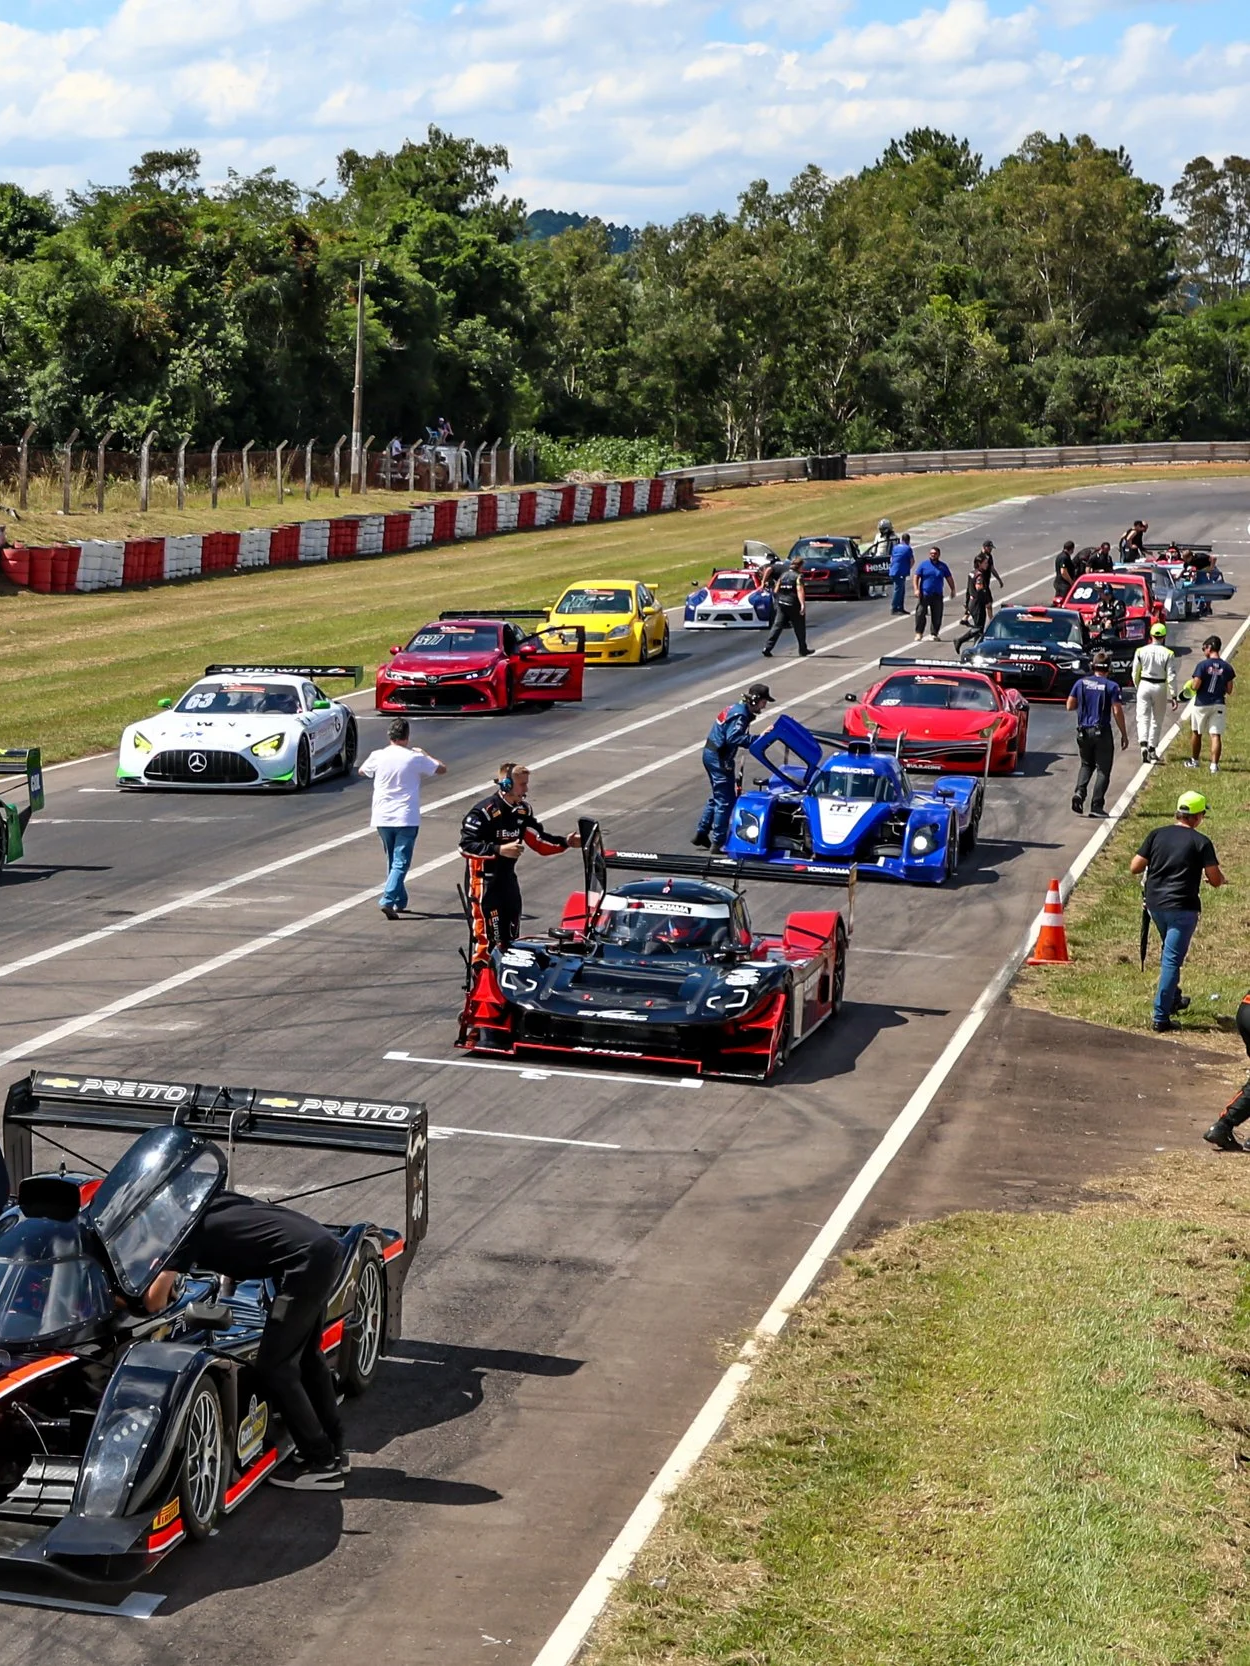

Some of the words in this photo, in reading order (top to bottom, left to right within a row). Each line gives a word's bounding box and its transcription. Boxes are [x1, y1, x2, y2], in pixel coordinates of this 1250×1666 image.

[1073, 587, 1093, 599] 88
[522, 668, 570, 684] 977
[184, 692, 217, 710] 63
[616, 851, 658, 860] YOKOHAMA
[806, 866, 850, 875] YOKOHAMA
[644, 902, 689, 914] YOKOHAMA
[79, 1078, 187, 1101] PRETTO
[299, 1098, 410, 1121] PRETTO
